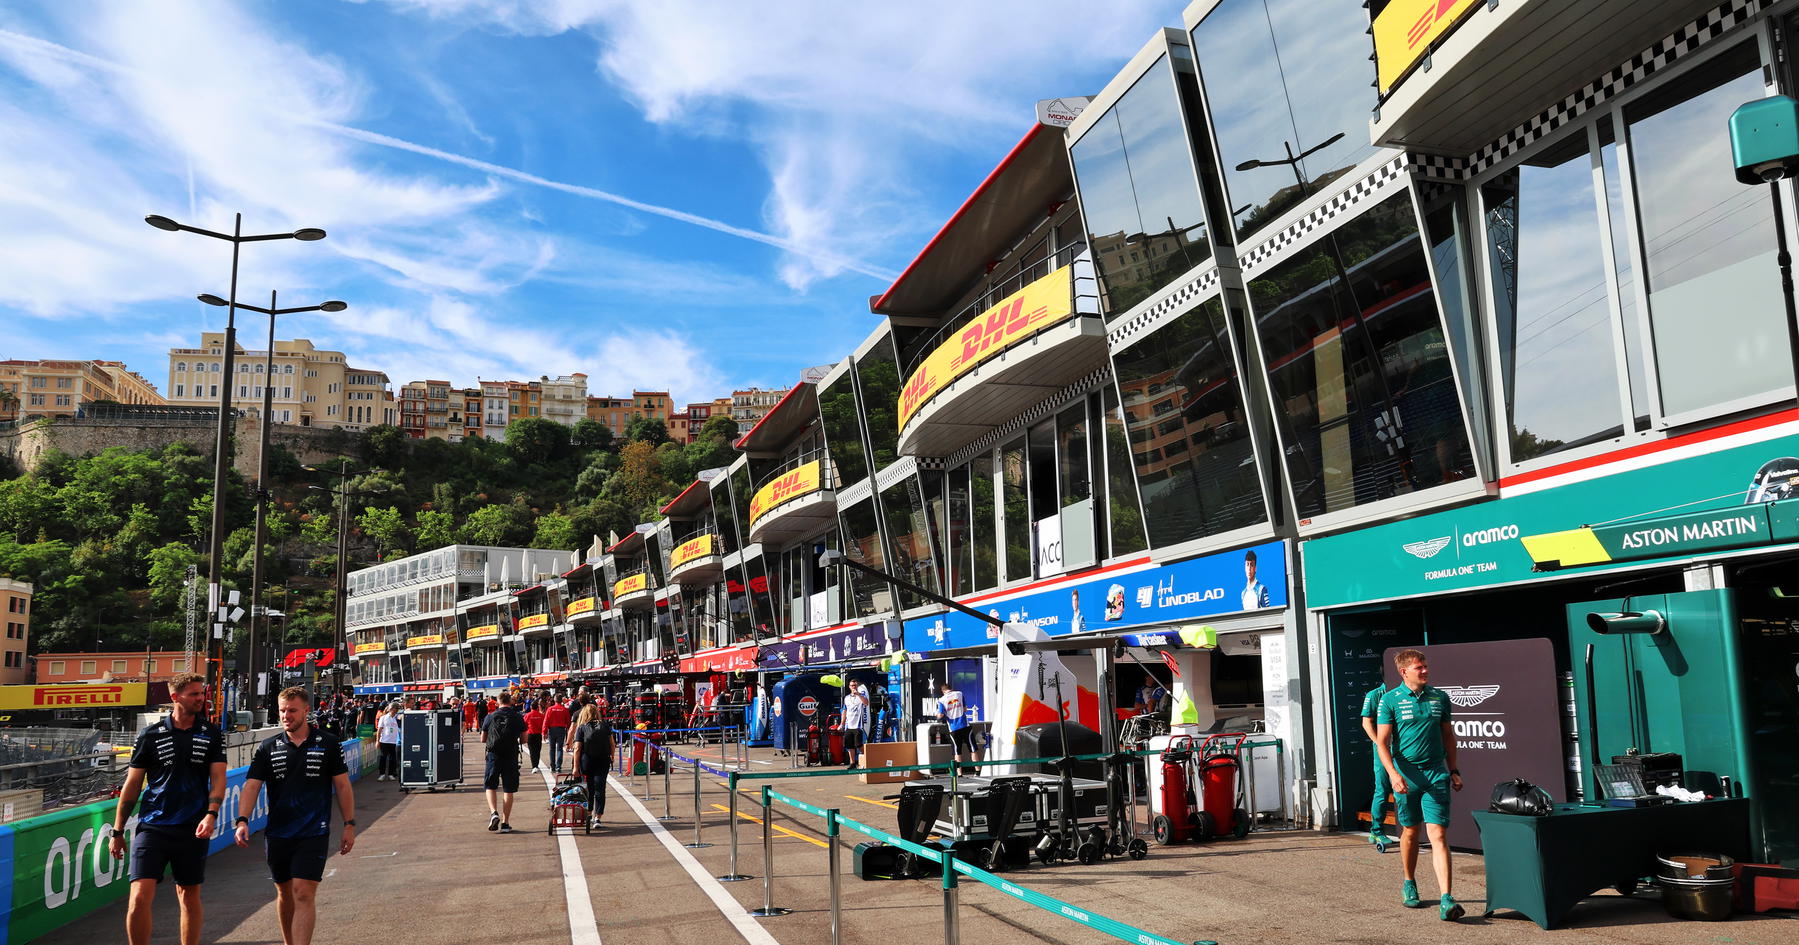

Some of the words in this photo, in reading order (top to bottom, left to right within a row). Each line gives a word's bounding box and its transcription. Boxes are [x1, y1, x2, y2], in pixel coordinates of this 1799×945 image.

[961, 296, 1031, 365] DHL
[903, 366, 930, 418] DHL
[772, 472, 801, 502] DHL
[1463, 524, 1519, 547] aramco
[1622, 526, 1679, 549] ASTON
[1683, 515, 1757, 542] MARTIN
[1424, 568, 1458, 580] FORMULA
[1476, 561, 1497, 573] TEAM
[1158, 587, 1225, 608] LINDBLAD
[1023, 615, 1059, 628] AWSON
[33, 686, 123, 705] PIRELLI
